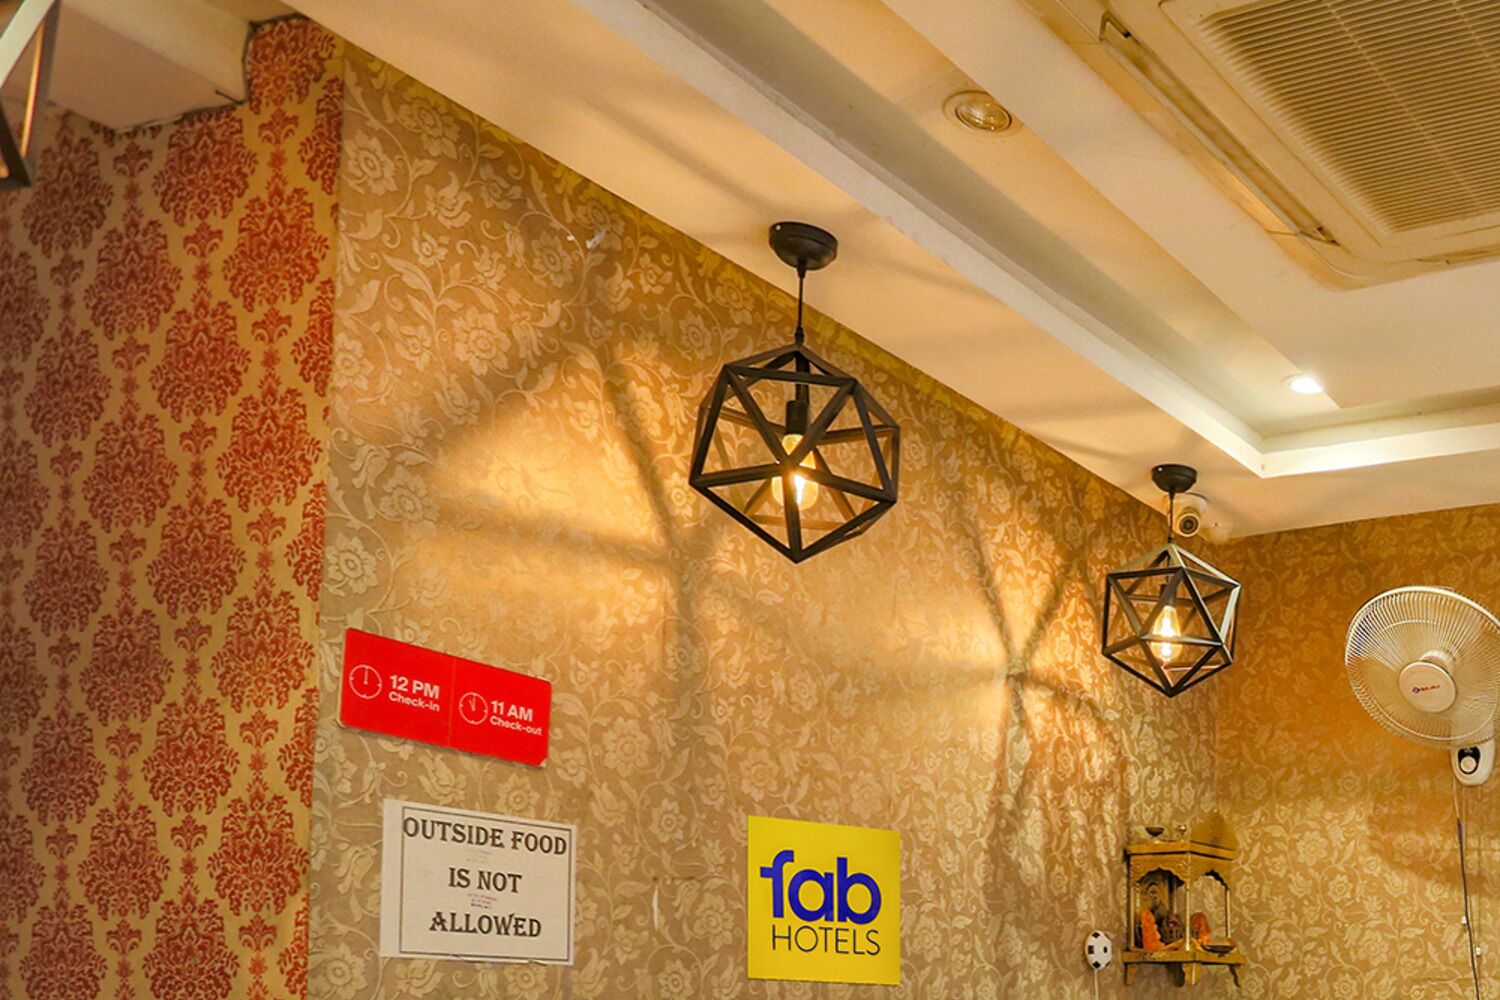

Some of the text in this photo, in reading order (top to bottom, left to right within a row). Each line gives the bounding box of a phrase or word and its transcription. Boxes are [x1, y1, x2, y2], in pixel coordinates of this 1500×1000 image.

[389, 674, 440, 700] 12 PM
[388, 691, 440, 712] Check-in
[491, 701, 533, 722] 11 AM
[490, 715, 543, 736] Check-out
[402, 816, 567, 855] OUTSIDE FOOD
[448, 867, 522, 893] IS NOT
[759, 849, 882, 925] fab
[429, 911, 542, 938] ALLOWED
[771, 924, 882, 956] HOTELS
